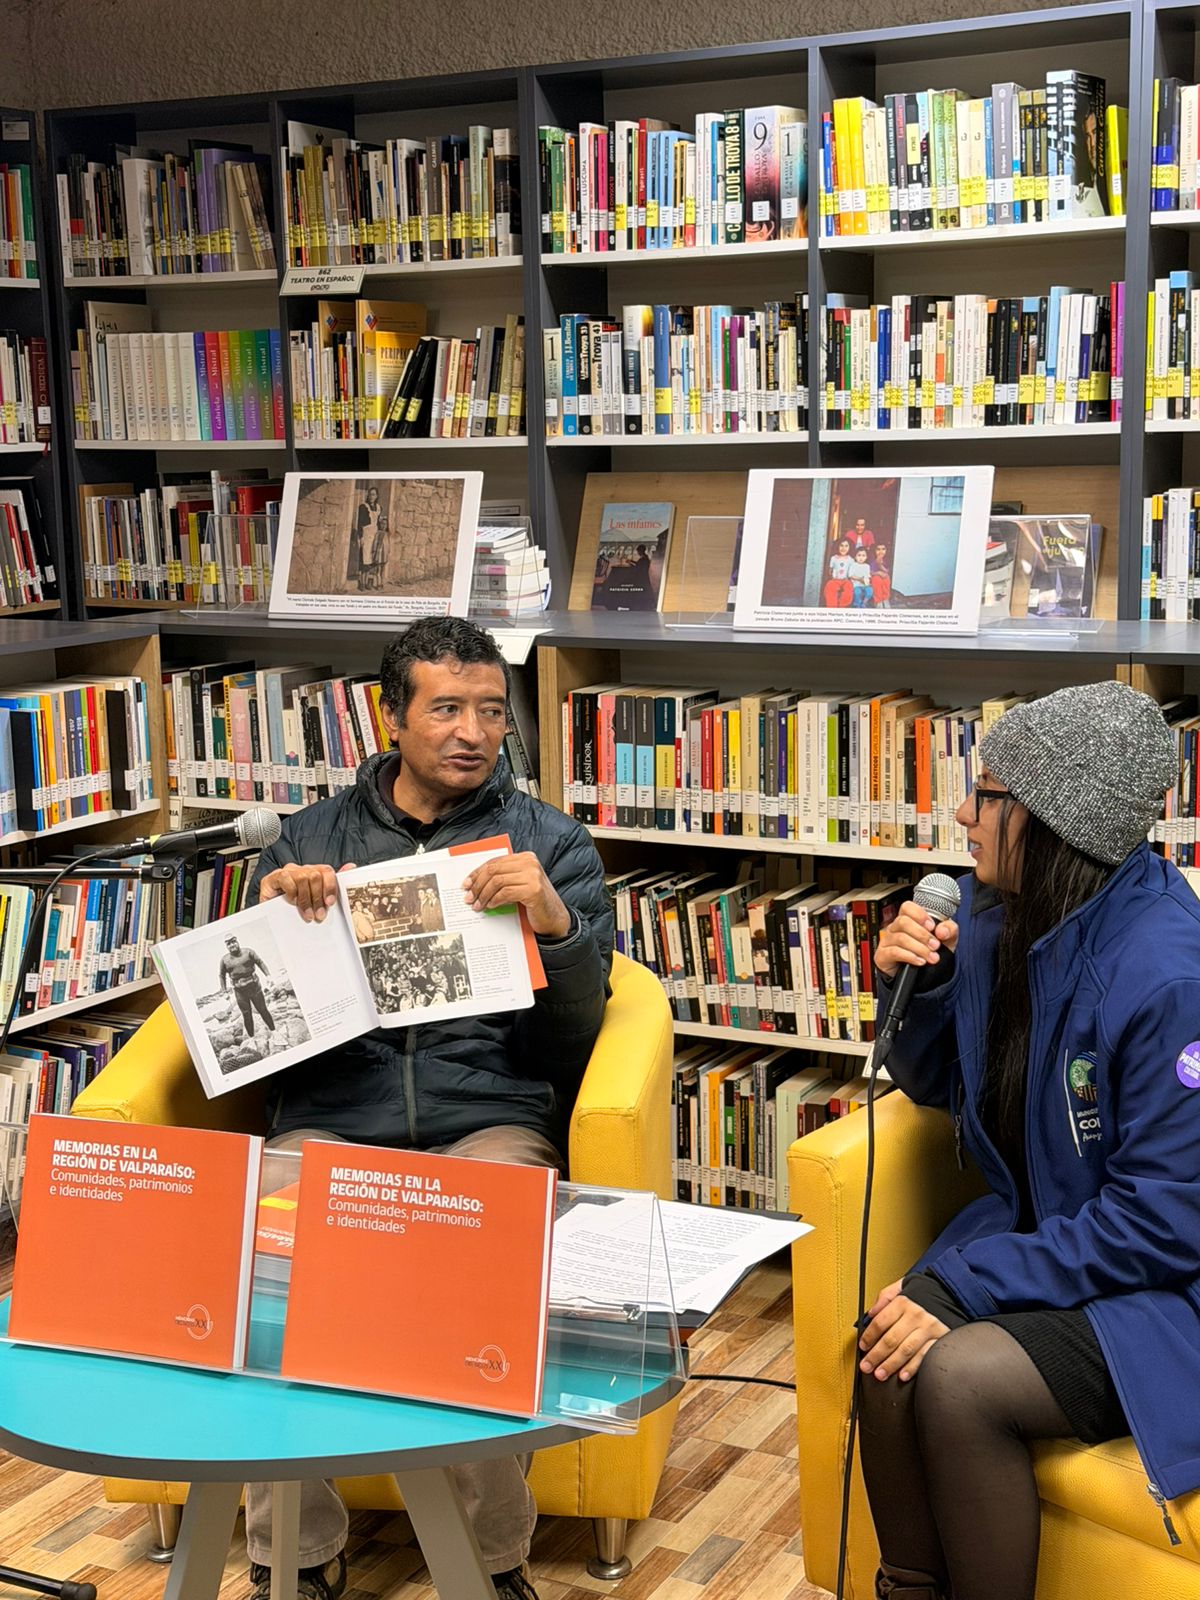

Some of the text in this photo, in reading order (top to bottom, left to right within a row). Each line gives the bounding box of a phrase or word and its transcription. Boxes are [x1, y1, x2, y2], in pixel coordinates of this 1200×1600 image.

[753, 121, 768, 150] 9
[725, 125, 741, 233] CLLO DE TROYA 8
[197, 350, 206, 376] Mistral
[259, 348, 267, 375] Mistral
[592, 336, 602, 364] Troya
[210, 350, 222, 430] Gabriela Mistral
[276, 396, 284, 430] Gabriela
[584, 739, 594, 786] QUISIDOR
[53, 1139, 157, 1160] MEMORIAS EN LA
[52, 1154, 196, 1180] REGIÓN DE VALPARAÍSO:
[330, 1167, 441, 1191] MEMORIAS EN LA
[49, 1184, 123, 1202] e identidades
[50, 1168, 193, 1194] Comunidades, patrimonios
[329, 1183, 484, 1212] REGIÓN DE VALPARAÍSO:
[327, 1213, 406, 1234] e identidades
[328, 1197, 482, 1228] Comunidades, patrimonios
